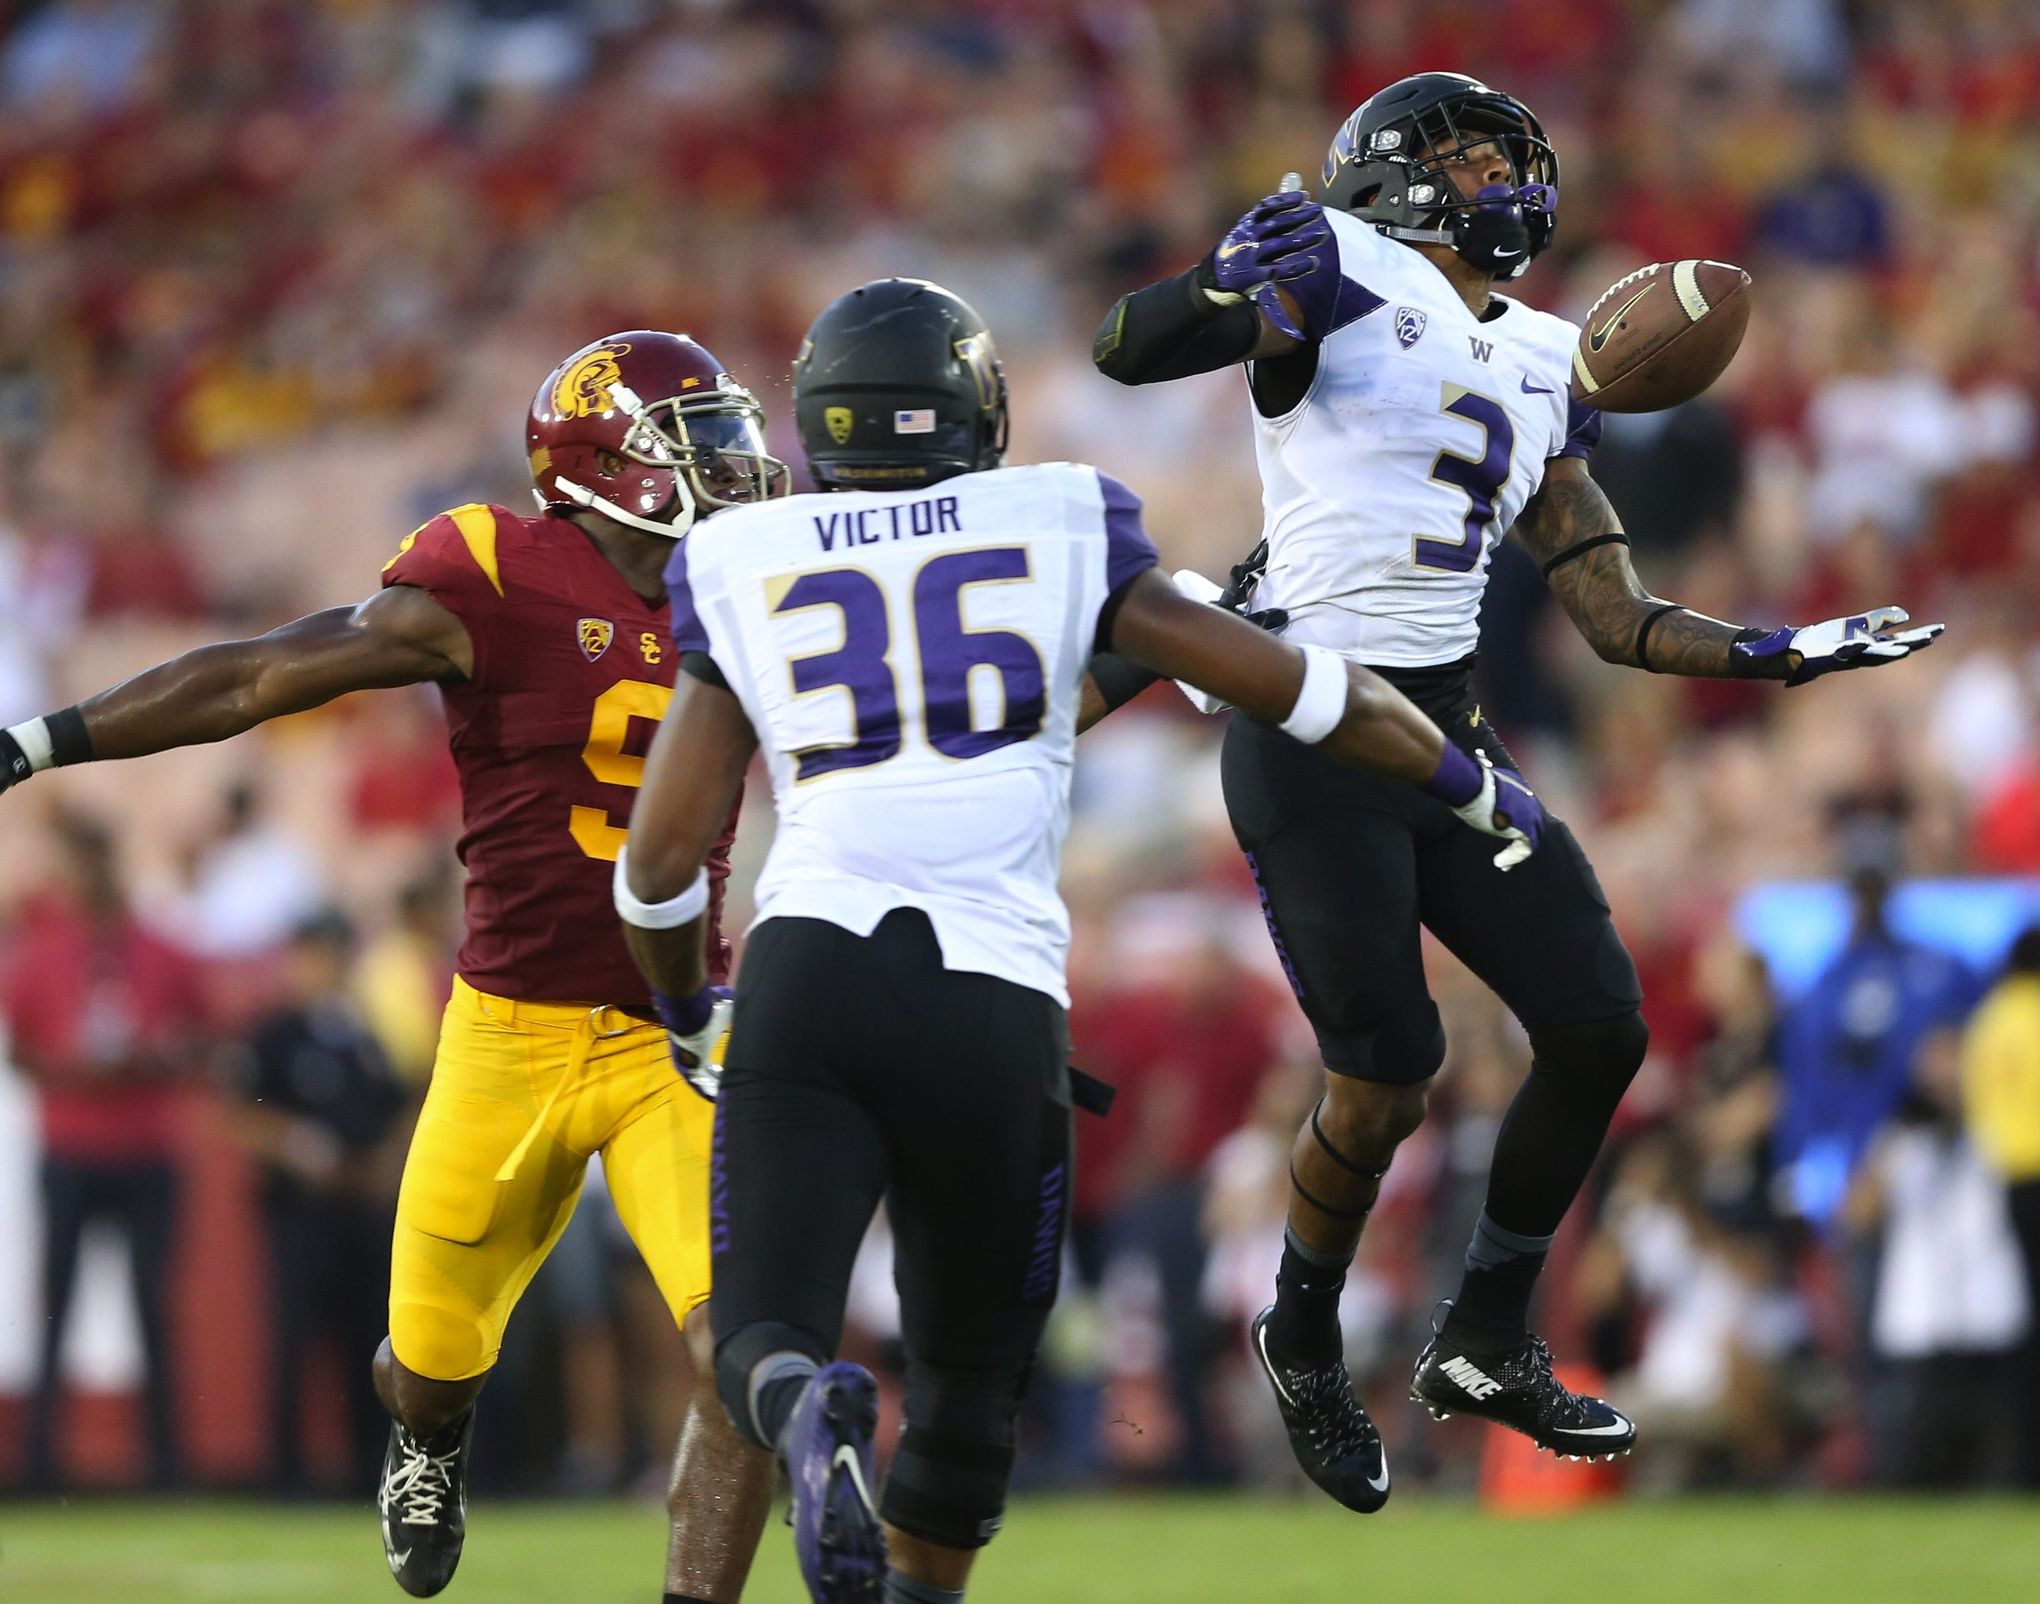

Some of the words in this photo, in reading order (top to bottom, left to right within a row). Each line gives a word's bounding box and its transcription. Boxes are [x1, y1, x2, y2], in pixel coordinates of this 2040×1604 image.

[1400, 324, 1416, 342] 12
[1467, 334, 1494, 363] W
[1411, 380, 1517, 573] 3
[813, 495, 962, 551] VICTOR
[763, 543, 1047, 787] 36
[1439, 1356, 1503, 1400] NIKE
